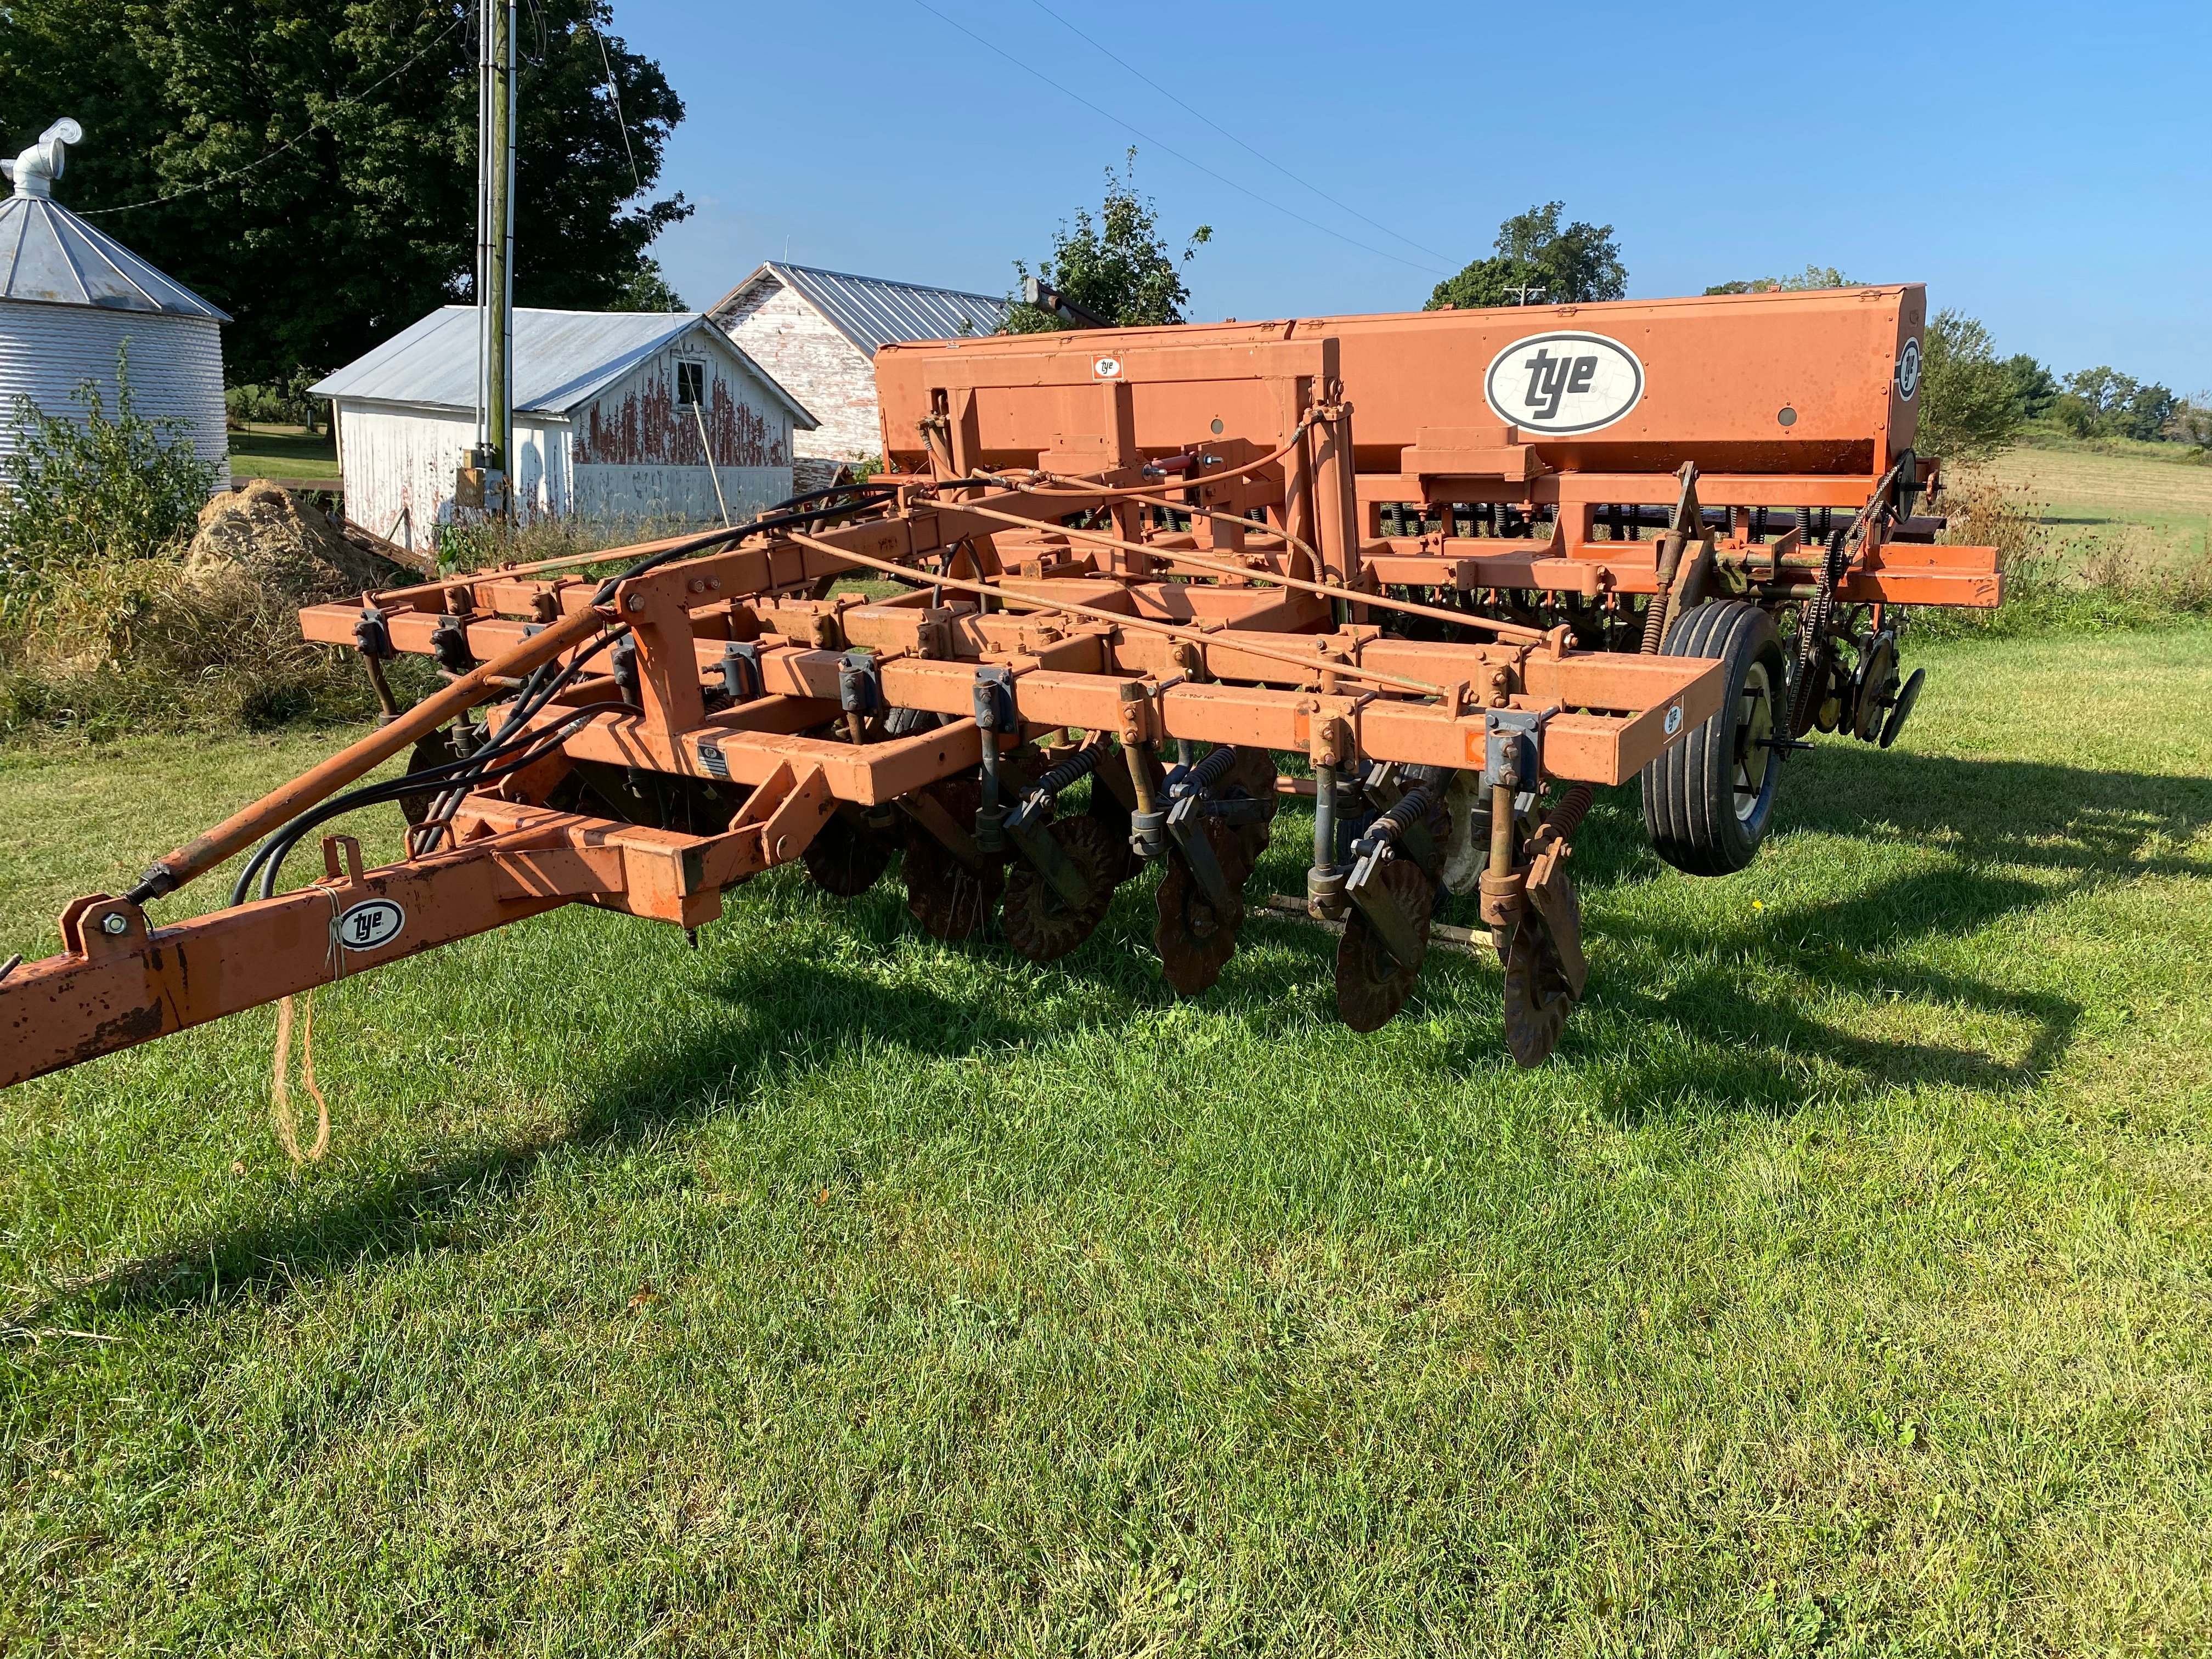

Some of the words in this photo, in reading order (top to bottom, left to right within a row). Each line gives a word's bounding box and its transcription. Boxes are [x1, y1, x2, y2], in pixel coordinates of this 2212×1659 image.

[1101, 360, 1113, 374] tye
[1904, 351, 1915, 388] tye
[1524, 348, 1598, 420] tye
[1668, 709, 1677, 731] tye
[353, 911, 382, 941] tye
